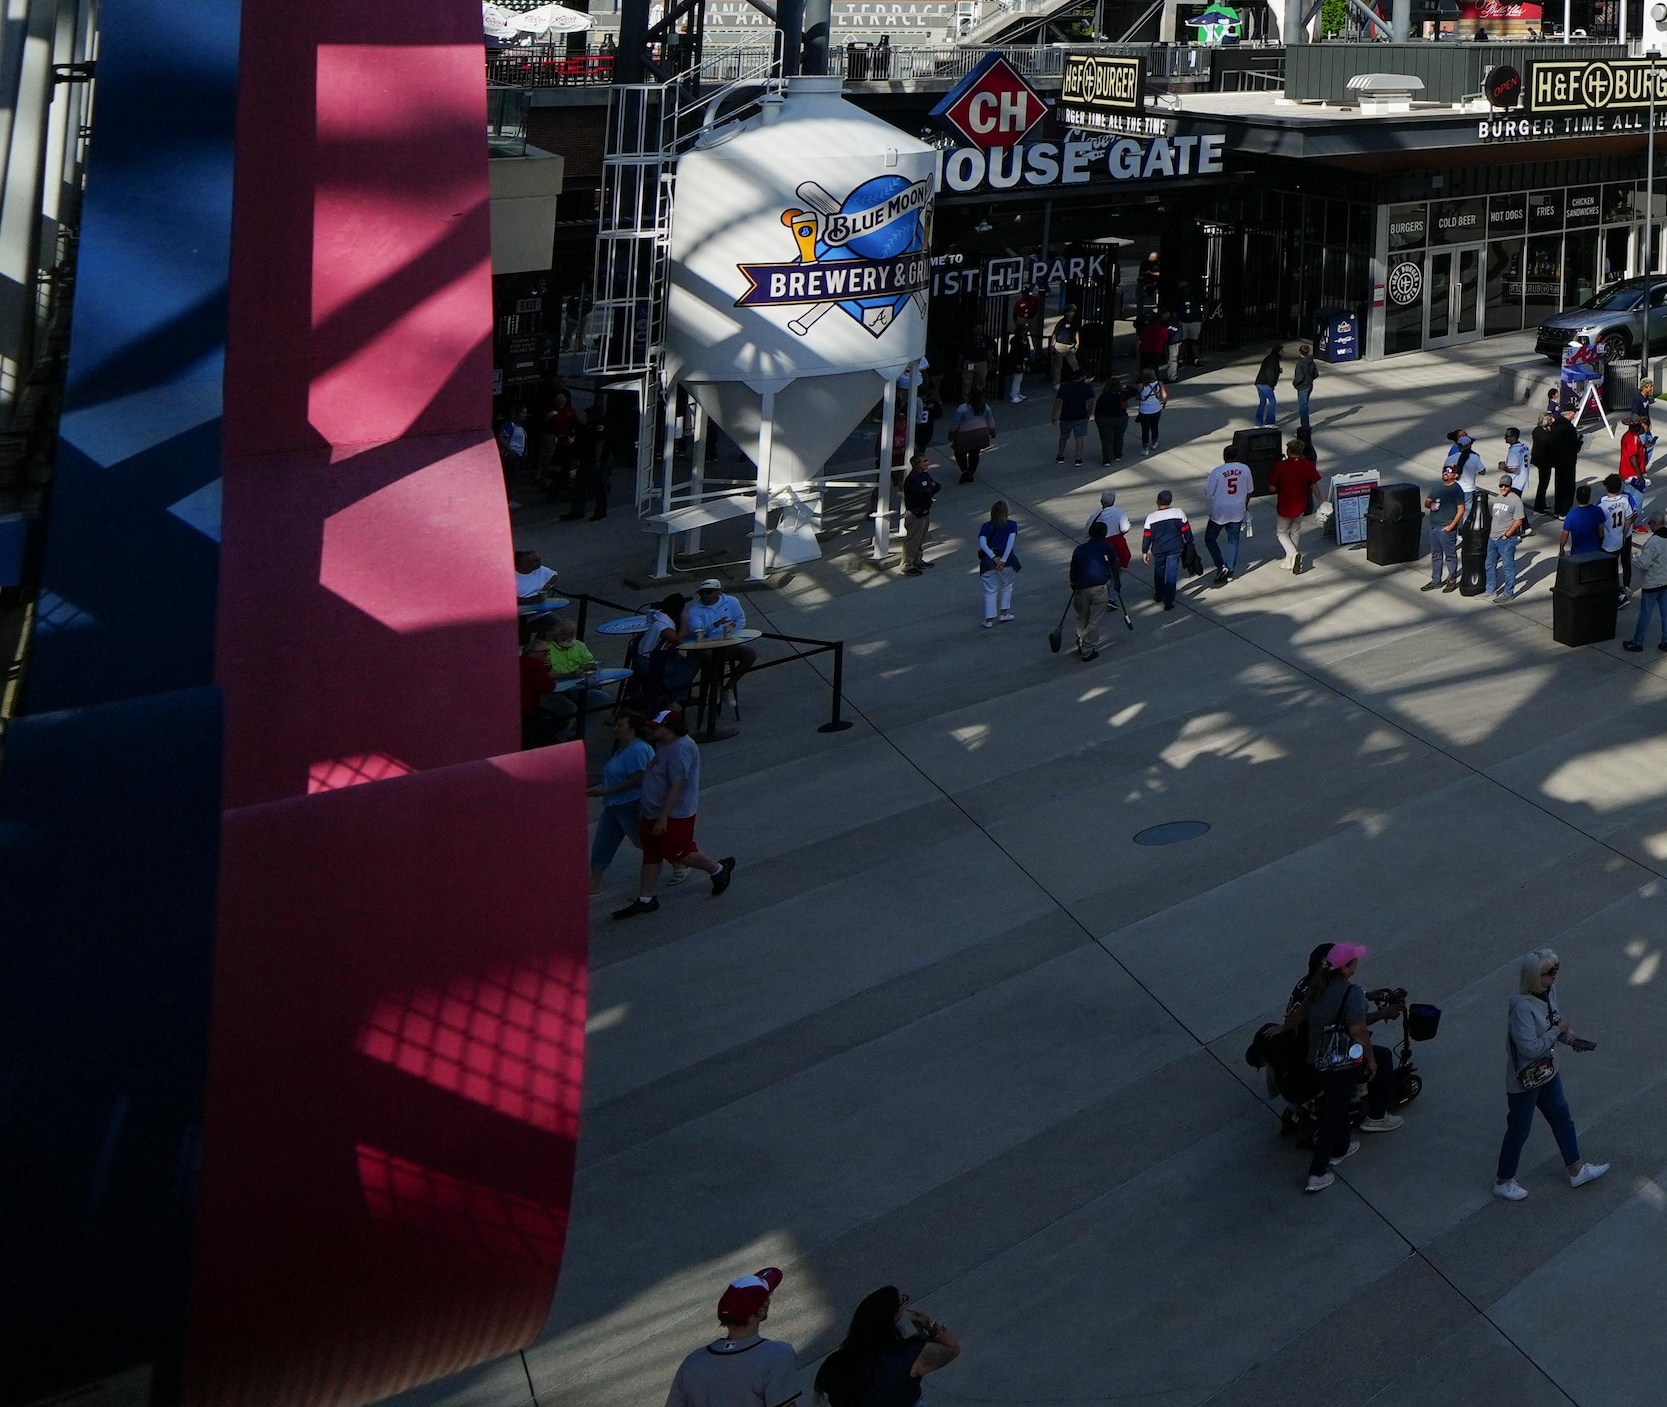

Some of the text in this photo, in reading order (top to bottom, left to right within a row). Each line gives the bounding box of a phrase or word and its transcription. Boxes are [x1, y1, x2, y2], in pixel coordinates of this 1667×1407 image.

[1065, 67, 1136, 99] H&F BURGER
[1493, 76, 1519, 99] OPEN
[1538, 70, 1581, 103] H&F
[968, 90, 1028, 134] CH
[1055, 108, 1166, 135] BURGER TIME ALL THE TIME
[1478, 119, 1554, 140] BURGER
[1564, 115, 1605, 133] TIME
[1612, 113, 1643, 130] ALL
[1108, 134, 1226, 180] GATE
[887, 188, 925, 220] MOON
[1536, 205, 1555, 217] FRIES
[1571, 196, 1595, 207] CHICKEN
[1490, 208, 1523, 222] HOT DOGS
[1566, 205, 1600, 218] SANDWICHES
[1390, 220, 1424, 235] BURGERS
[1438, 214, 1476, 229] COLD BEER
[949, 253, 964, 265] TO
[1031, 254, 1106, 284] PARK
[769, 266, 888, 299] BREWERY
[895, 266, 906, 287] &
[1393, 287, 1418, 302] ATLANTA
[1222, 468, 1243, 478] BENCH
[1227, 477, 1238, 495] 5
[1611, 510, 1624, 529] 11
